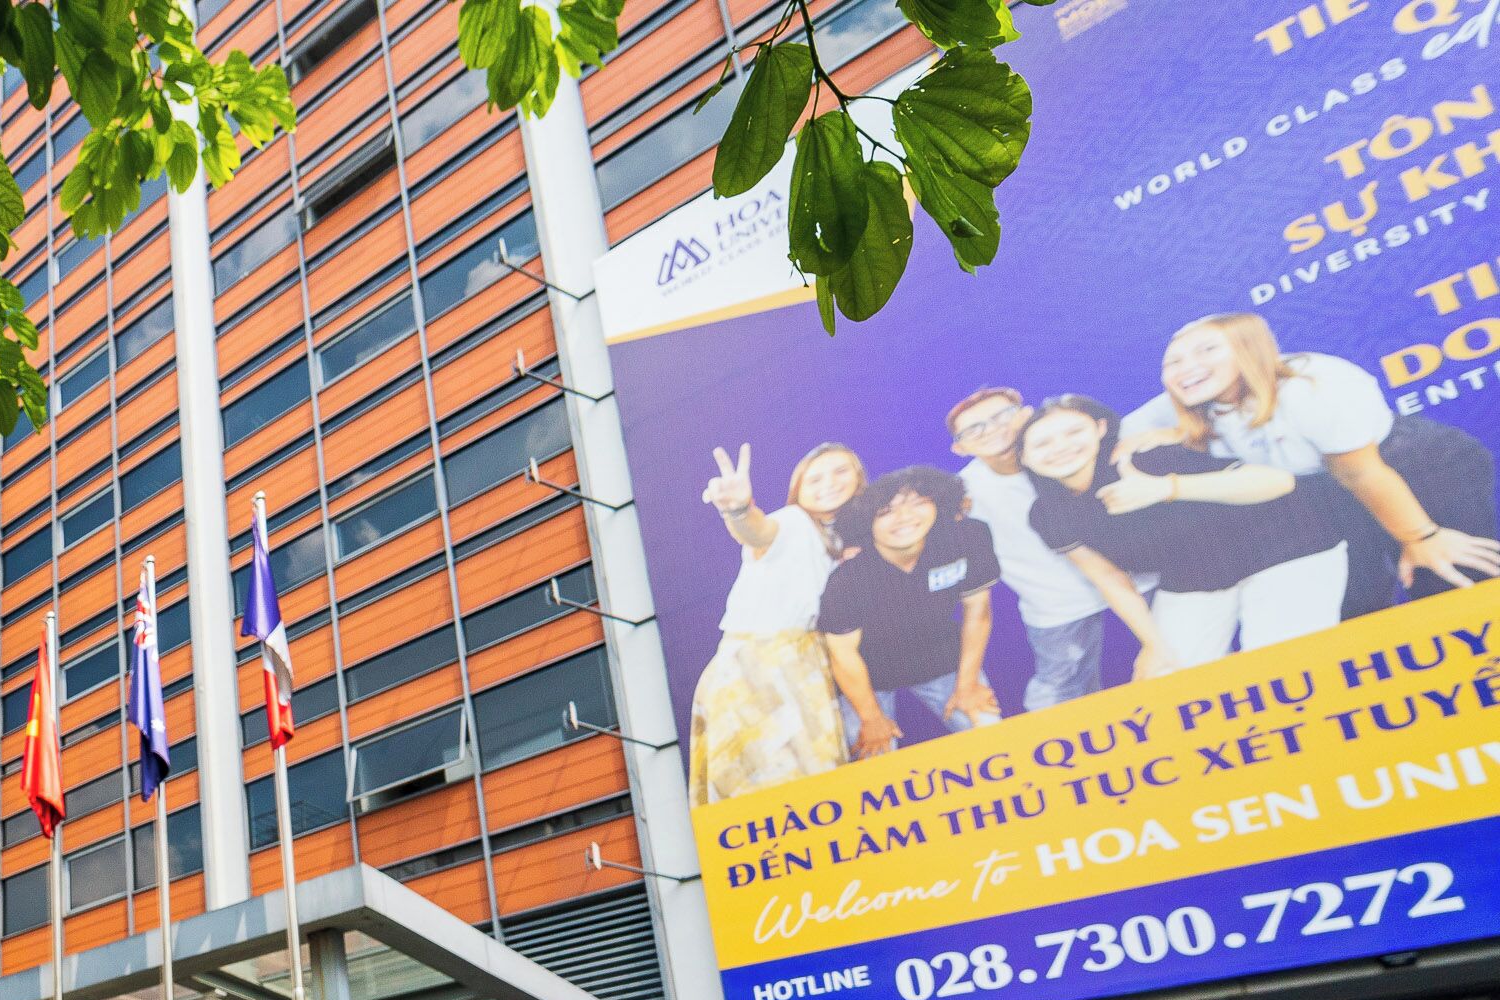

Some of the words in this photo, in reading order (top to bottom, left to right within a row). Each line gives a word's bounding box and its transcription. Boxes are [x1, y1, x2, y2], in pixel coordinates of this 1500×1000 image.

[1113, 136, 1248, 211] WORLD
[1265, 57, 1407, 137] CLASS
[1324, 84, 1495, 180] TÔN
[1249, 187, 1490, 306] DIVERSITY
[1283, 180, 1379, 254] SỰ
[1414, 256, 1500, 316] TI
[1395, 360, 1500, 417] ENT
[717, 799, 844, 850] CHÀO
[860, 753, 1015, 815] MỪNG
[1032, 707, 1154, 769] QUÝ
[1177, 671, 1315, 732] PHỤ
[1339, 621, 1492, 689] HUY
[727, 841, 814, 889] ĐẾN
[828, 820, 928, 865] LÀM
[939, 782, 1047, 837] THỦ
[1062, 756, 1181, 806] TỤC
[1197, 725, 1308, 775] XÉT
[753, 879, 961, 945] Welcome
[972, 849, 1023, 902] to
[1034, 819, 1181, 878] HOA
[1191, 784, 1320, 844] SEN
